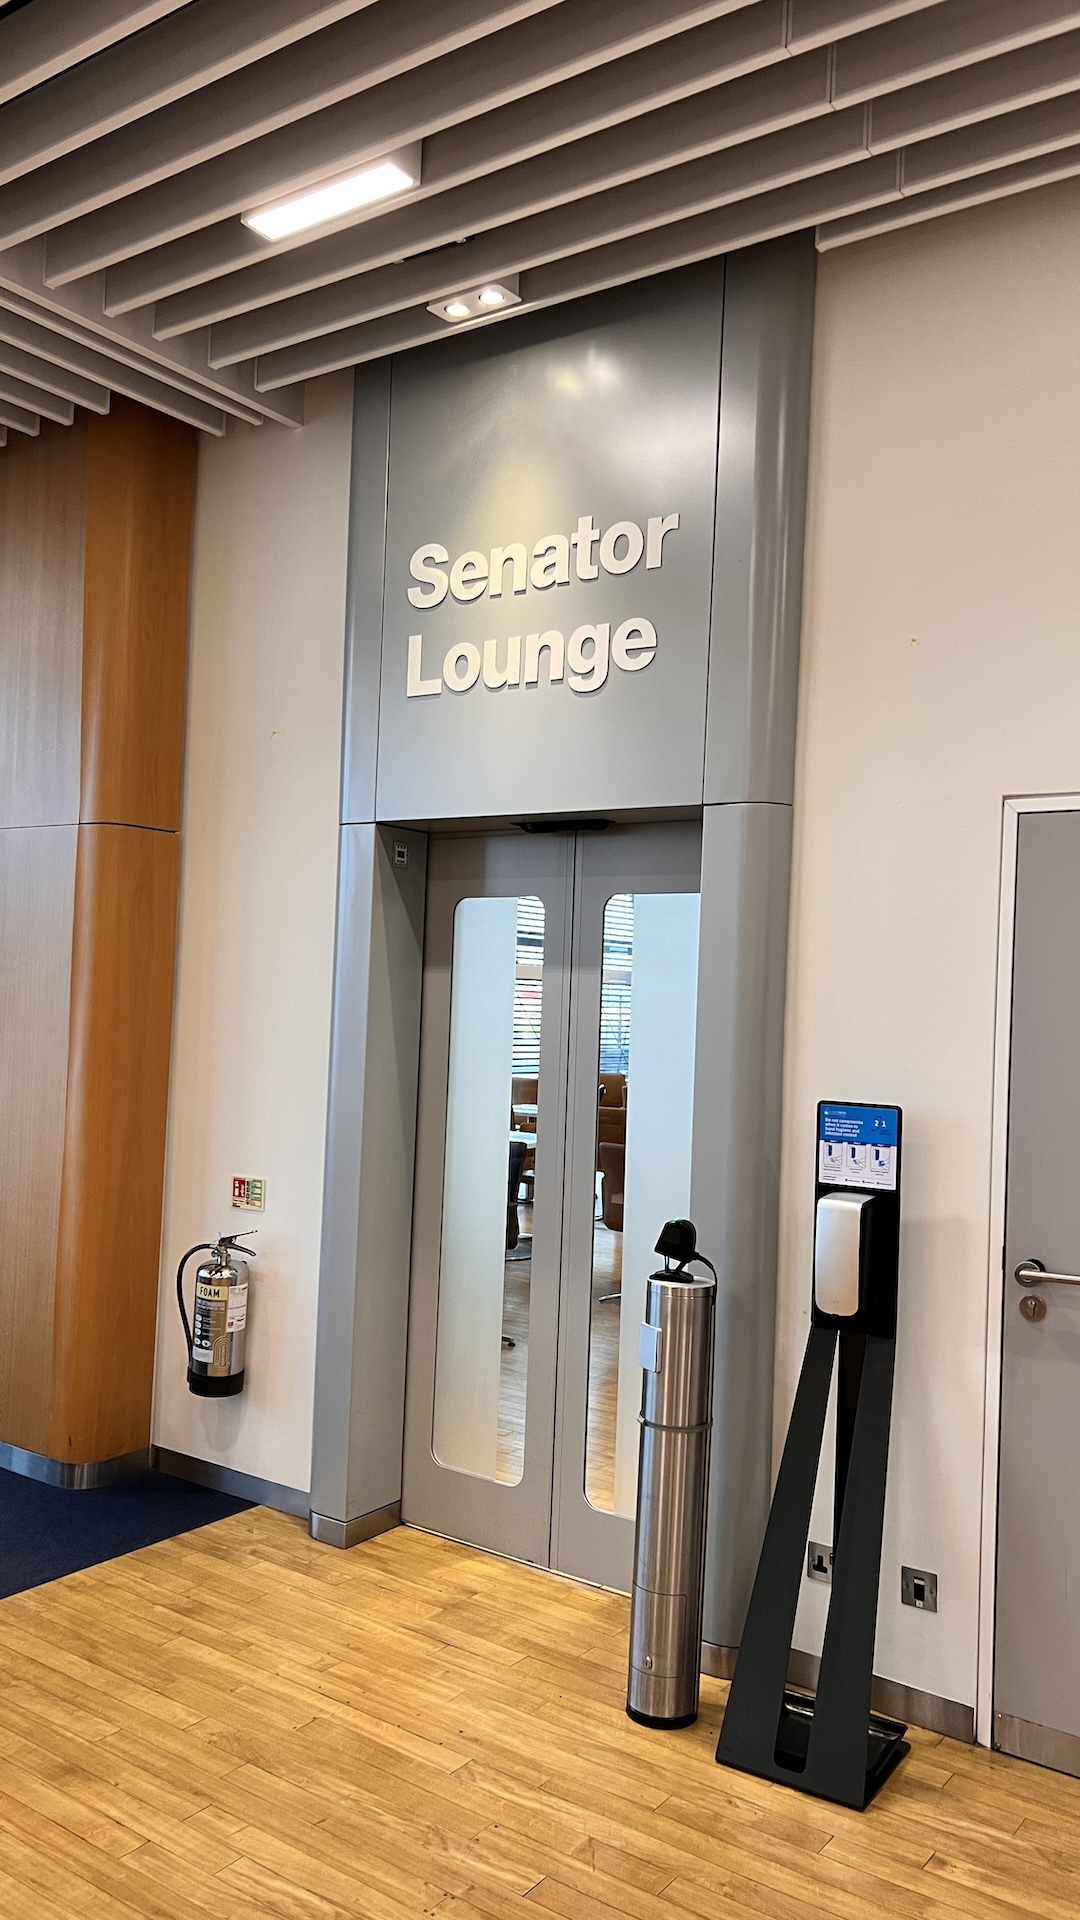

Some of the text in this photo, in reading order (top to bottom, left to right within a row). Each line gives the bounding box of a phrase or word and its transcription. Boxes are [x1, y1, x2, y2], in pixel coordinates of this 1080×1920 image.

[407, 513, 679, 609] Senator
[407, 617, 657, 698] Lounge
[200, 1286, 220, 1298] FOAM
